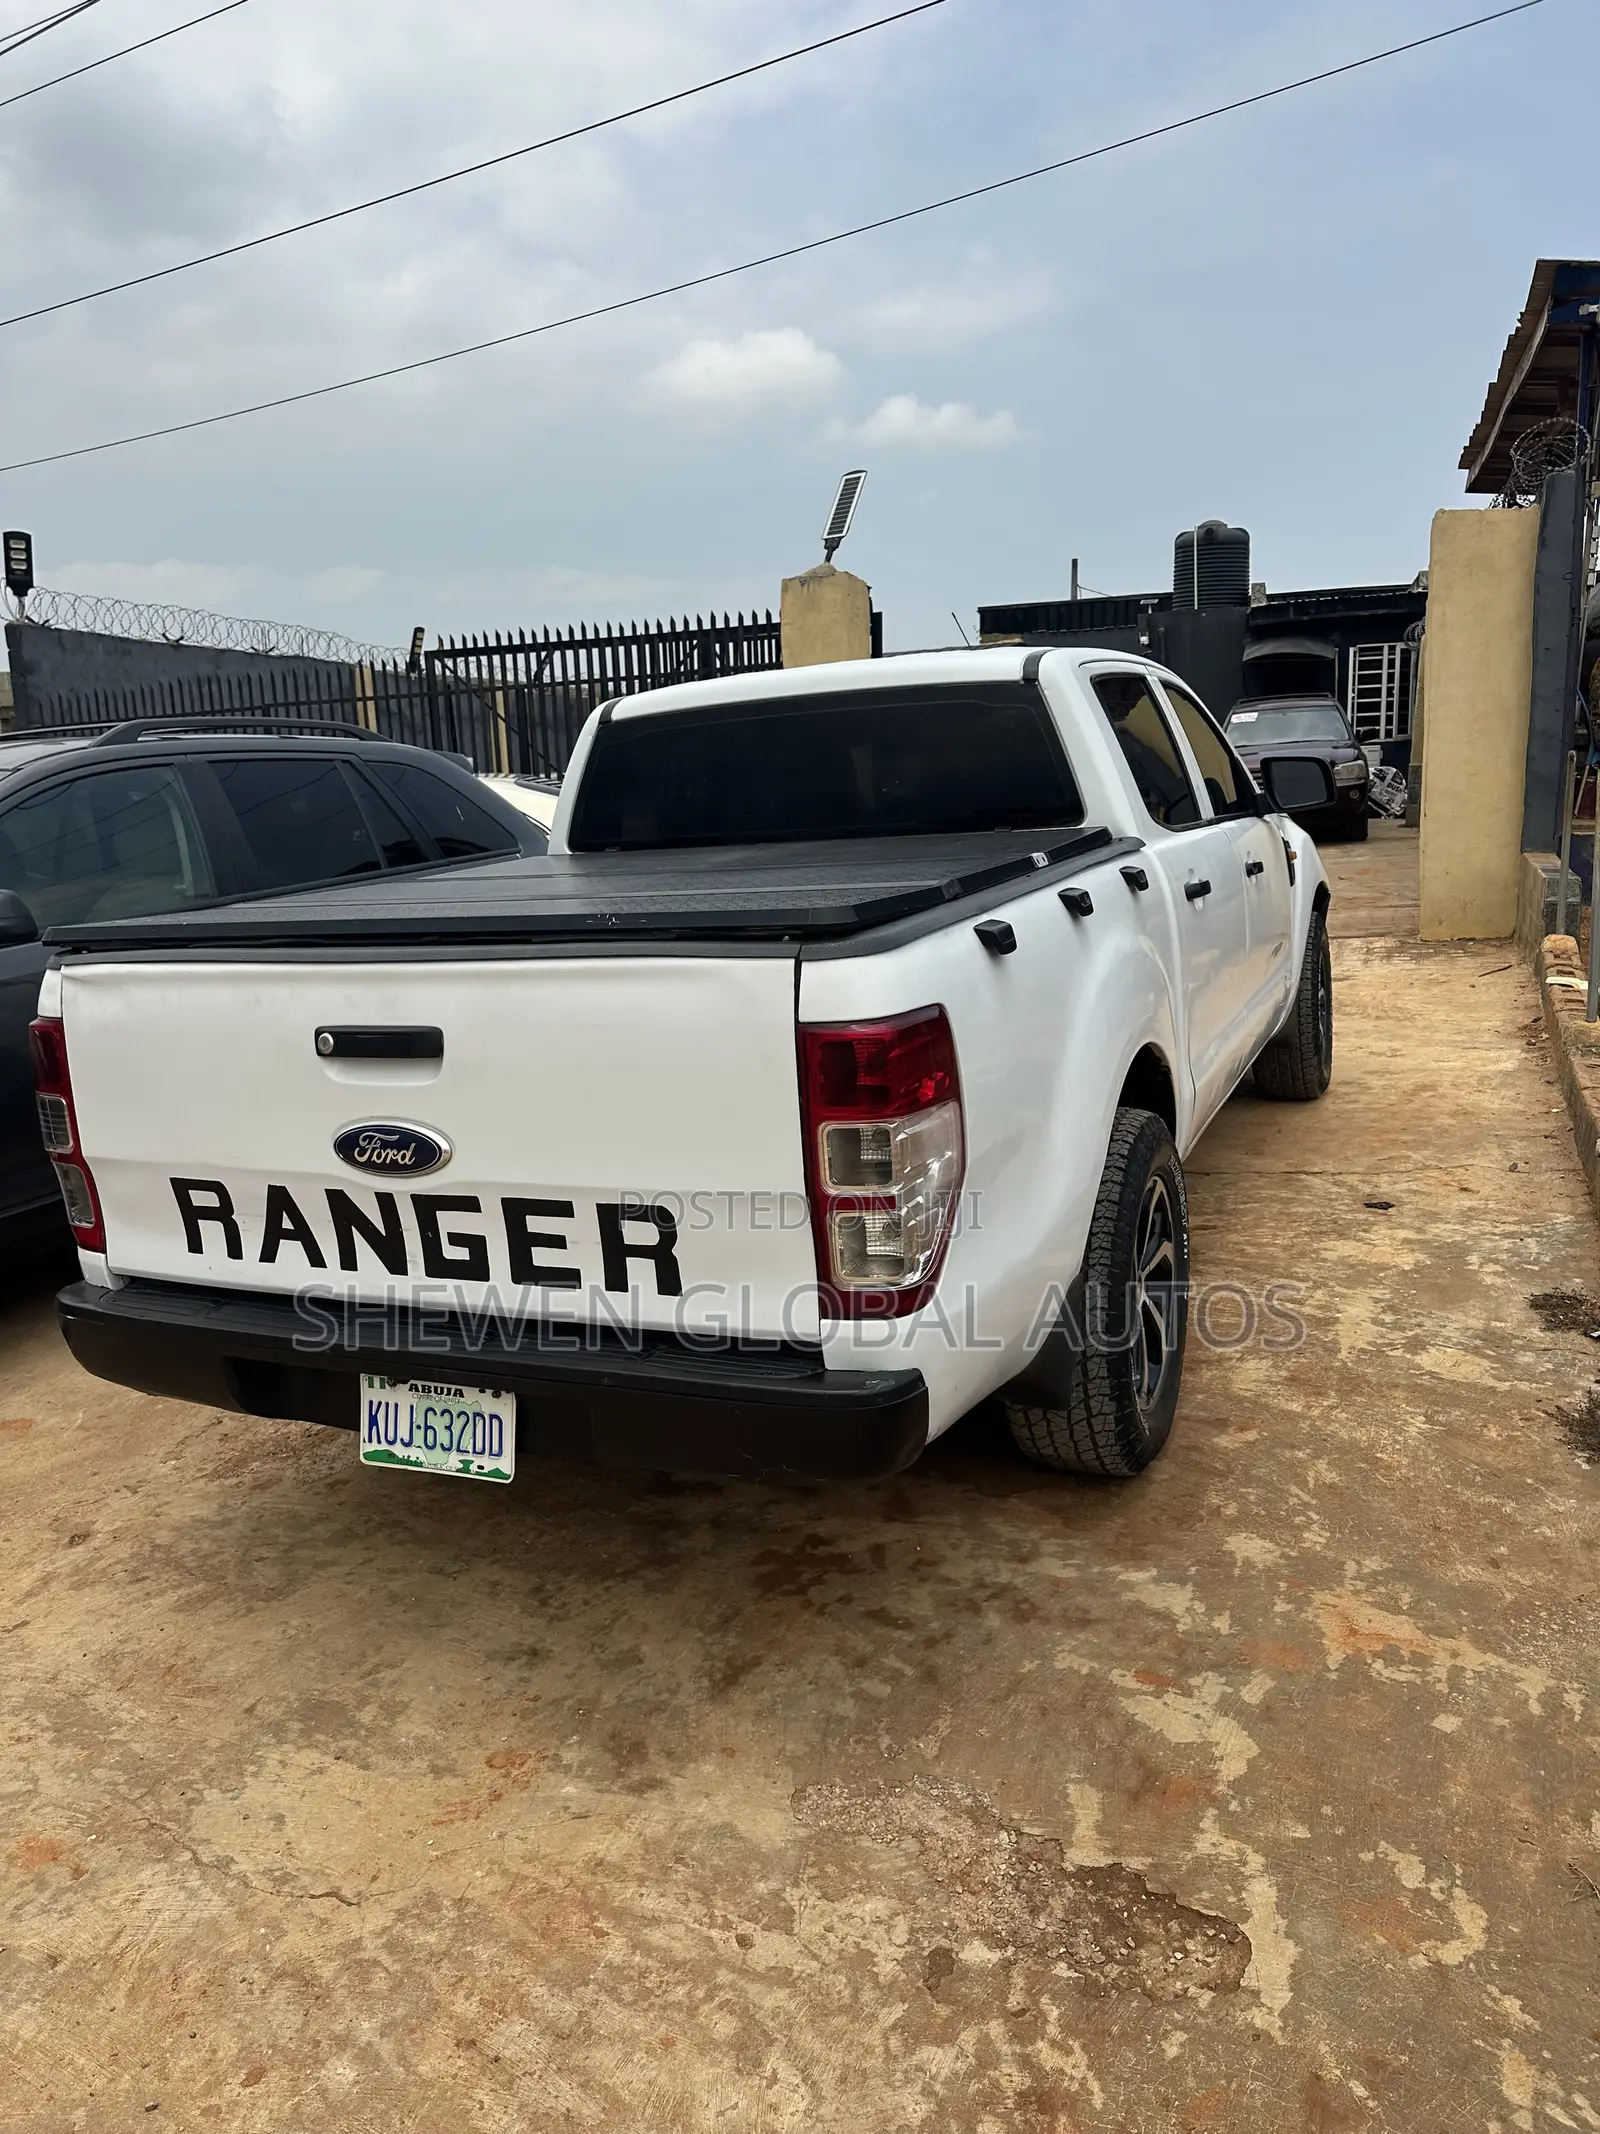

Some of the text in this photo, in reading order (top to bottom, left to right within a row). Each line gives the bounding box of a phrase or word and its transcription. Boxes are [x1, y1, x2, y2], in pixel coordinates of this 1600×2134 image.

[354, 1131, 416, 1165] Ford
[169, 1177, 684, 1297] RANGER
[408, 1383, 465, 1398] ABUJA
